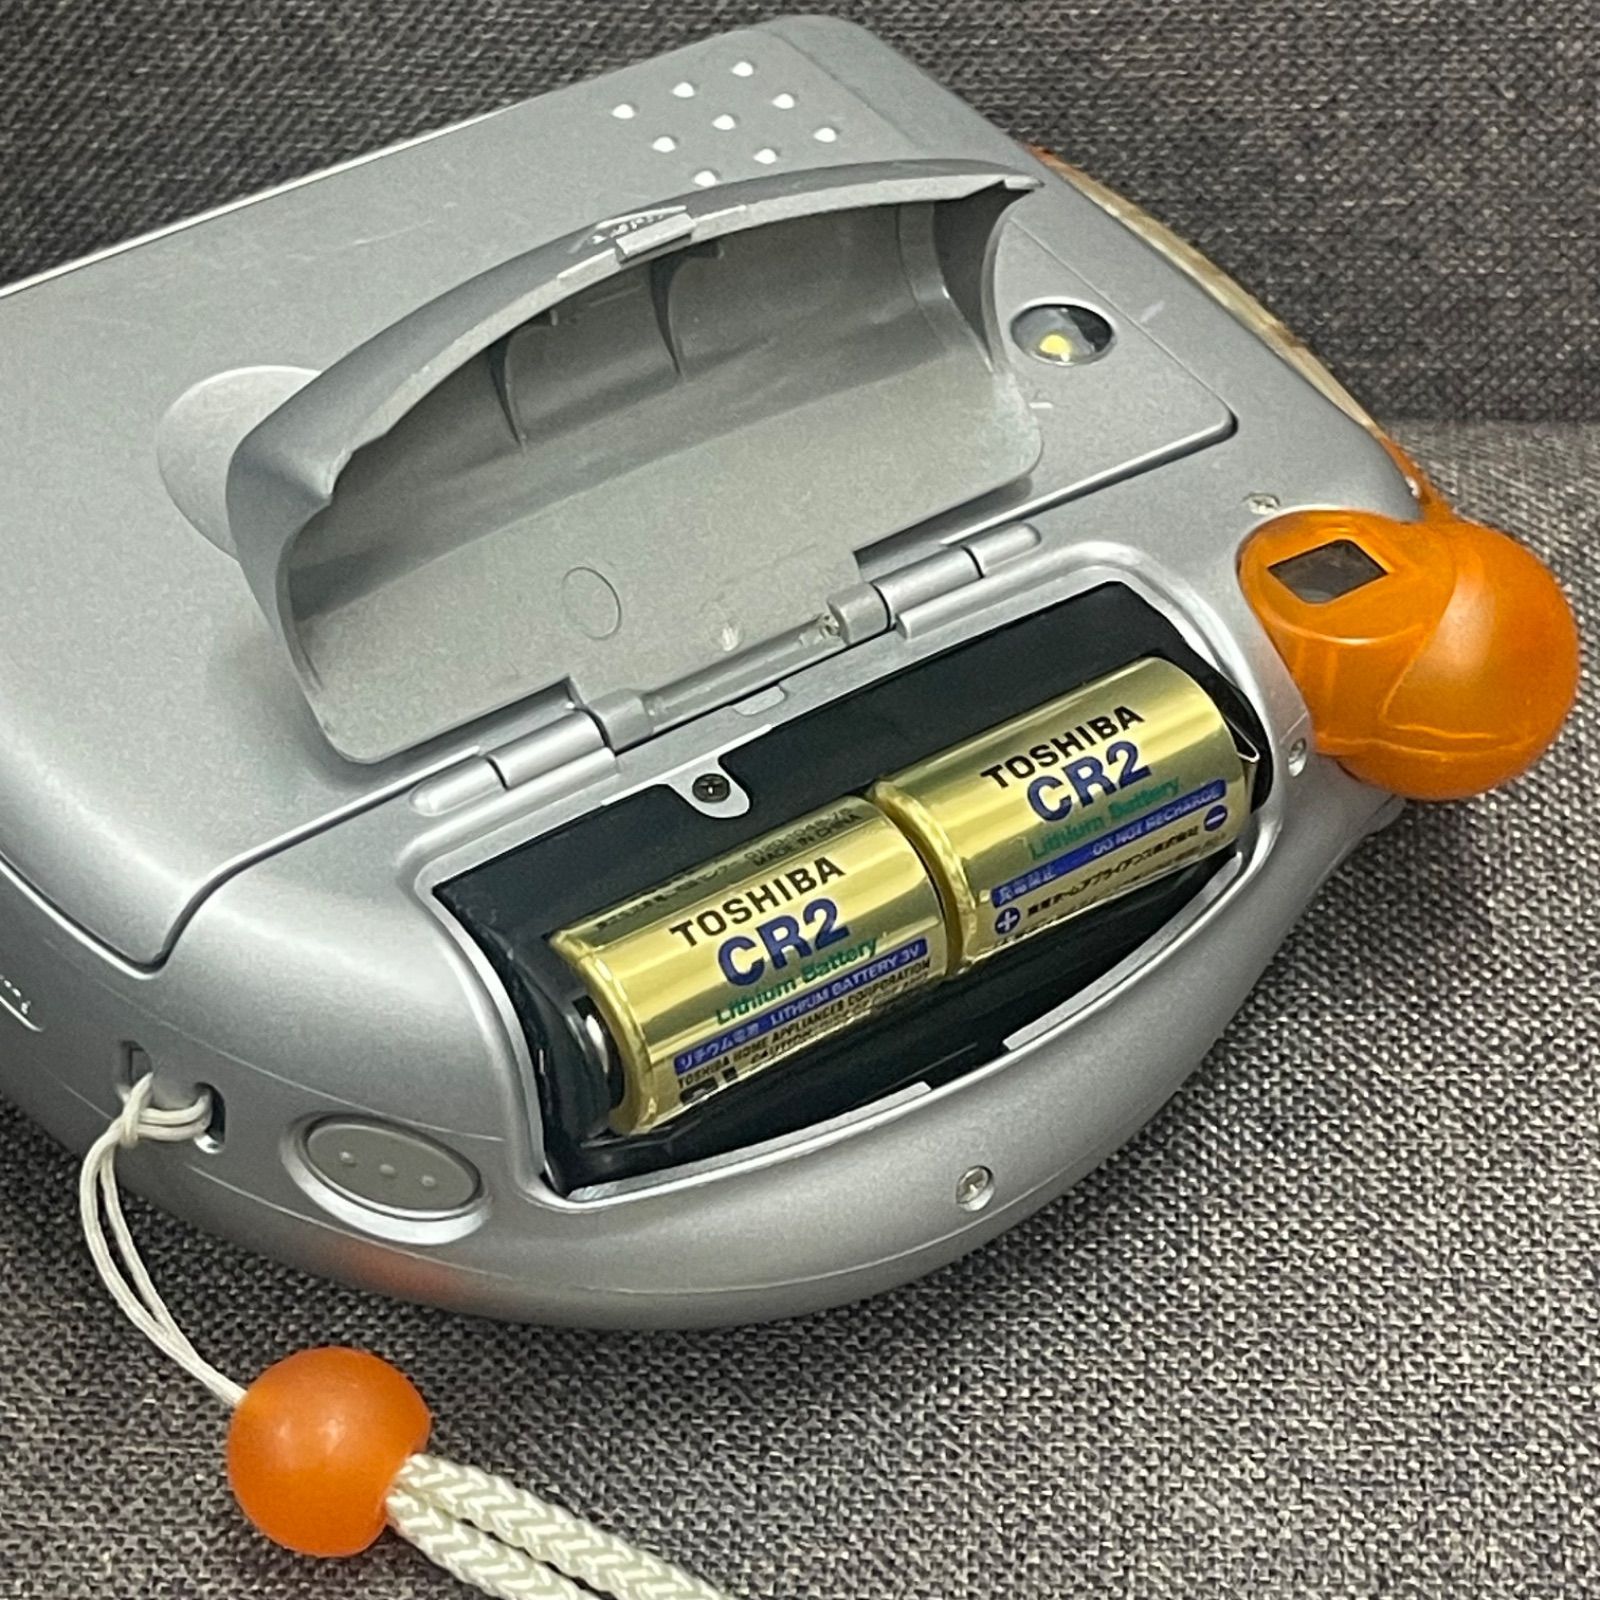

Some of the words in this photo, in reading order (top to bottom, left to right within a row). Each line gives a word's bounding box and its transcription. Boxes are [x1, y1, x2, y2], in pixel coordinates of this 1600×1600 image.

[980, 705, 1146, 789] TOSHIBA
[1026, 740, 1152, 822] CR2
[815, 813, 863, 838] CHINA
[1029, 817, 1105, 860] Lithium
[1108, 777, 1179, 819] Battery
[1144, 788, 1220, 829] RECHARGE
[670, 857, 845, 947] TOSHIBA
[718, 898, 850, 986] CR2
[716, 978, 796, 1025] Lithium
[801, 937, 877, 983] Battery
[770, 988, 830, 1026] LITHIUM
[831, 955, 899, 998] BATTERY
[899, 943, 921, 962] 3V
[678, 1055, 731, 1089] TOSHIBA
[732, 1038, 769, 1062] HOME
[771, 998, 845, 1044] APPLIANCES
[846, 957, 931, 1006] CORPORATION
